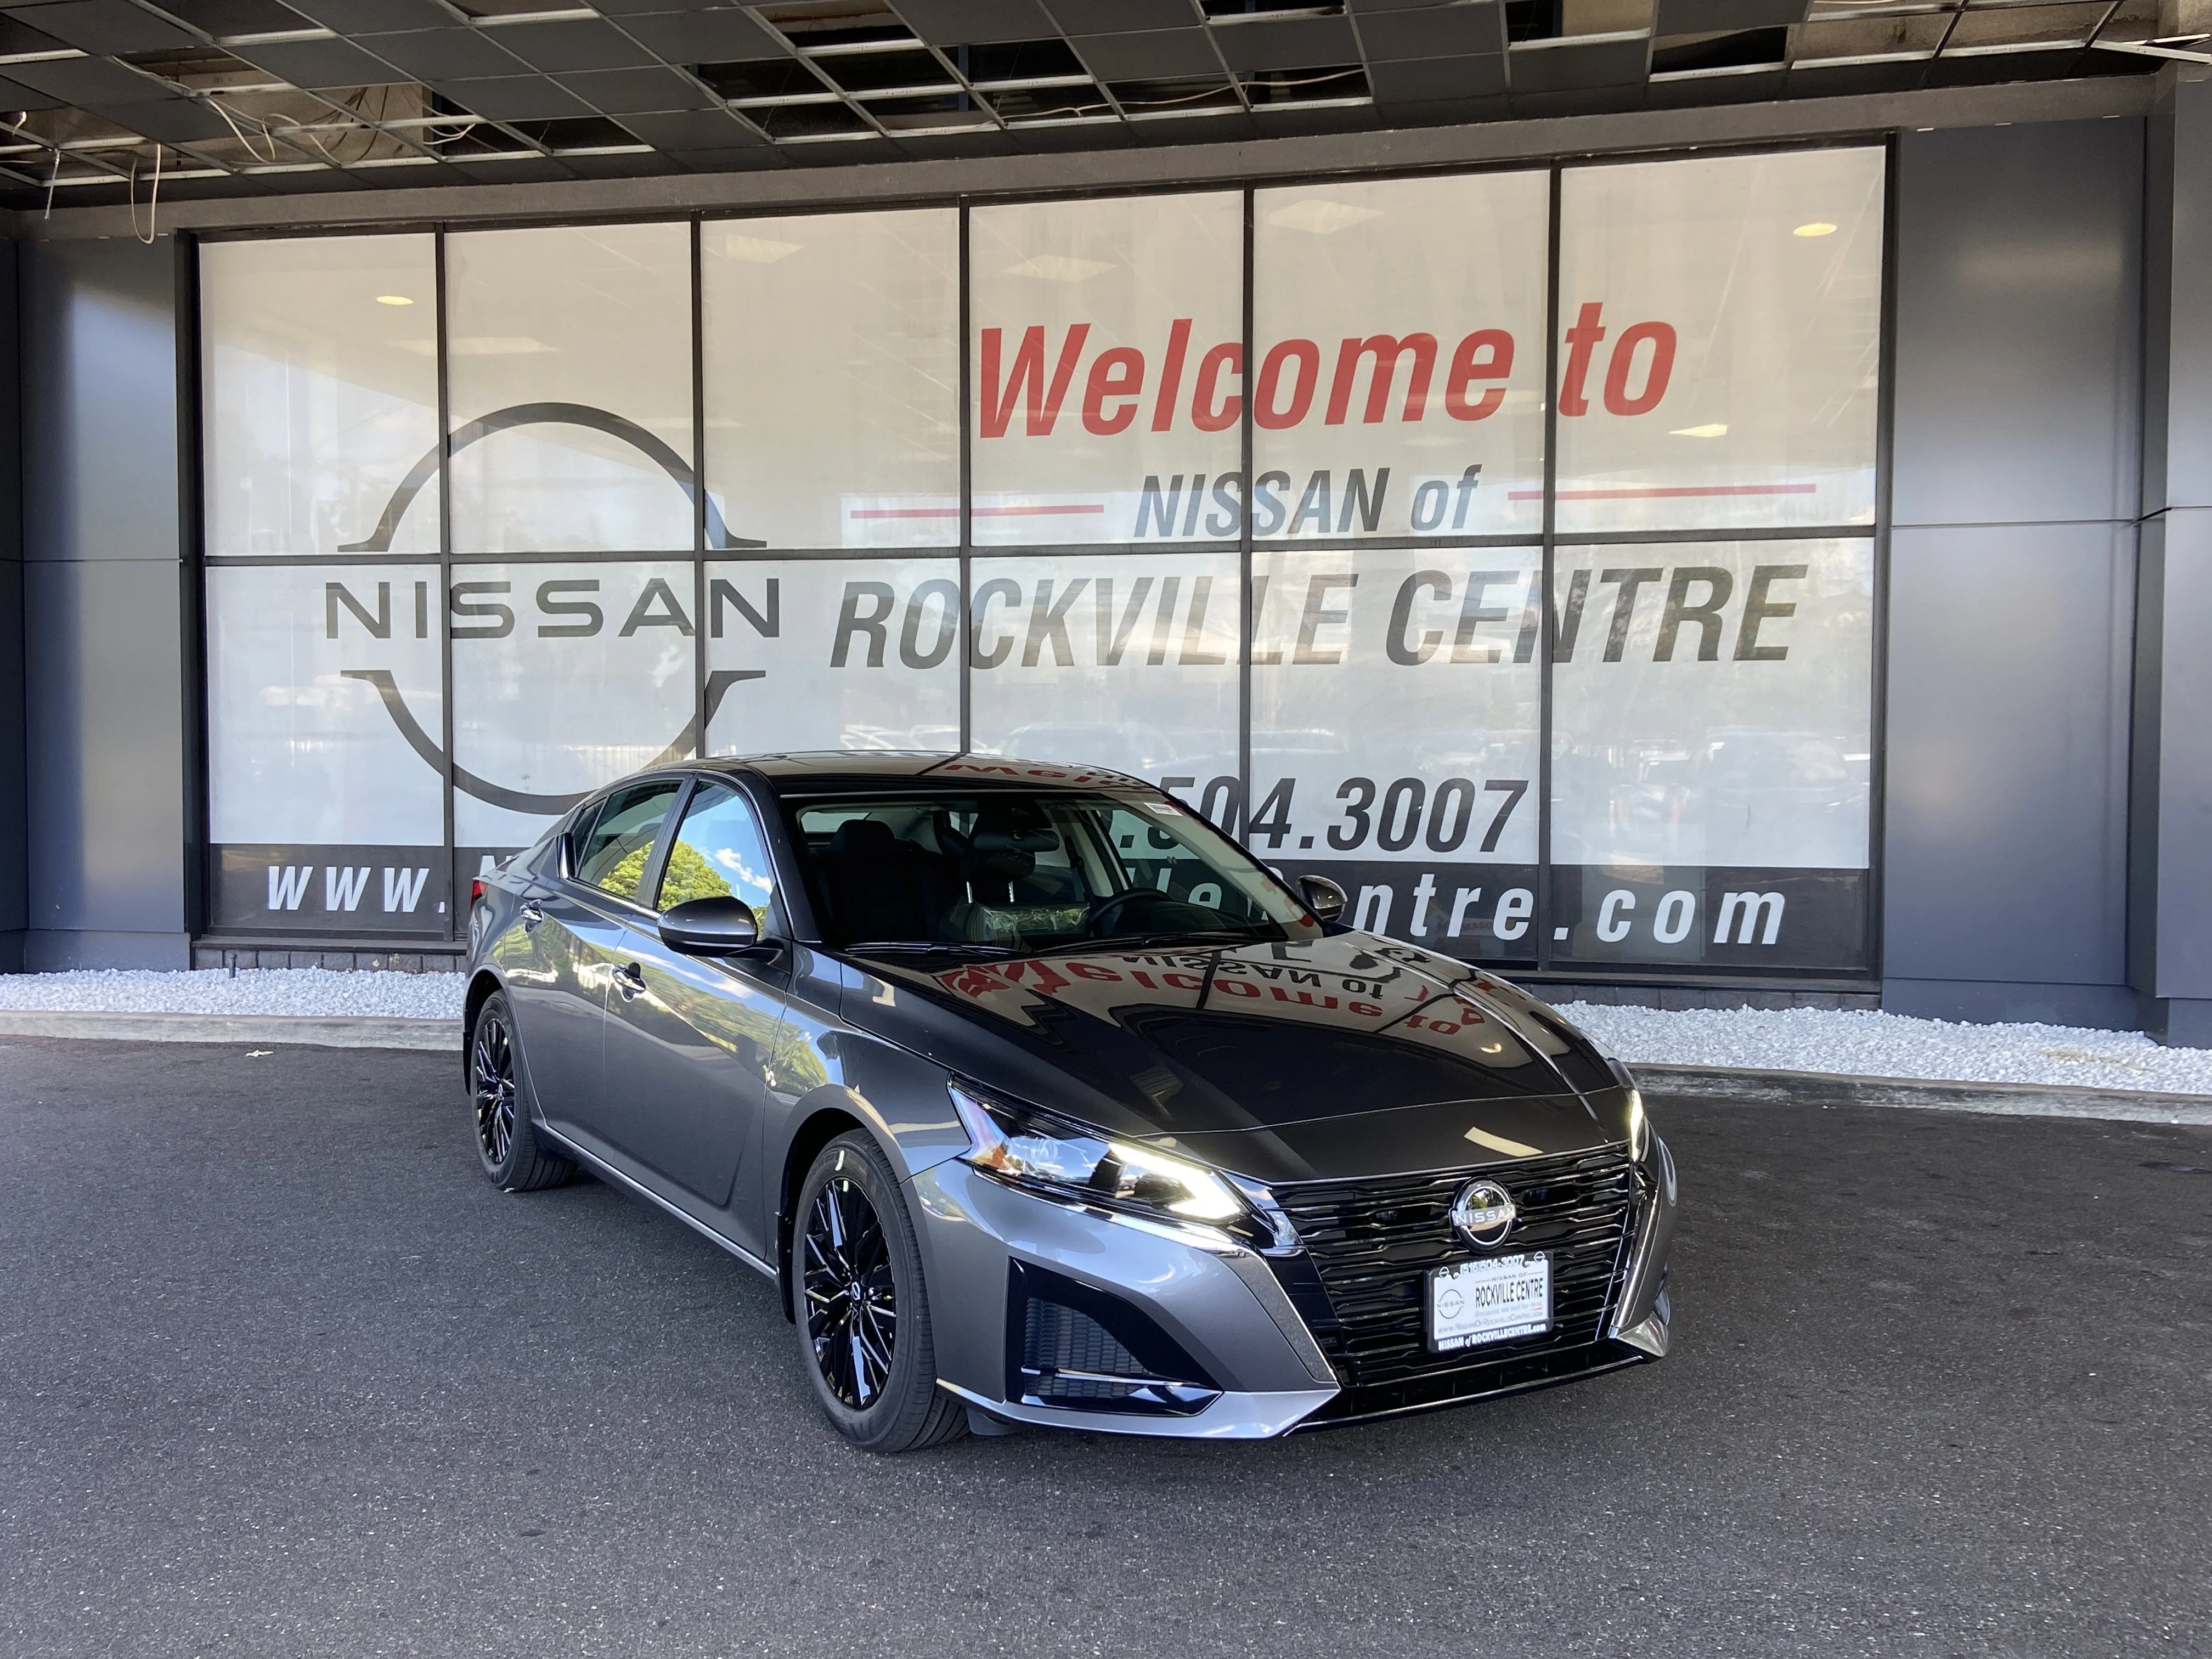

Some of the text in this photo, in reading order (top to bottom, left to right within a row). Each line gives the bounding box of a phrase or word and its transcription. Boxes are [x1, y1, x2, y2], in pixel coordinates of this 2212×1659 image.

[979, 302, 1678, 440] Welcome to
[1133, 464, 1482, 539] NISSAN of
[326, 578, 779, 640] NISSAN
[830, 564, 1808, 670] ROCKVILLE CENTRE
[1453, 1205, 1515, 1225] NISSAN
[1436, 1300, 1465, 1308] NISSAN
[1476, 1277, 1543, 1308] ROCKVILLE CENTRE
[1438, 1336, 1464, 1352] NISSAN
